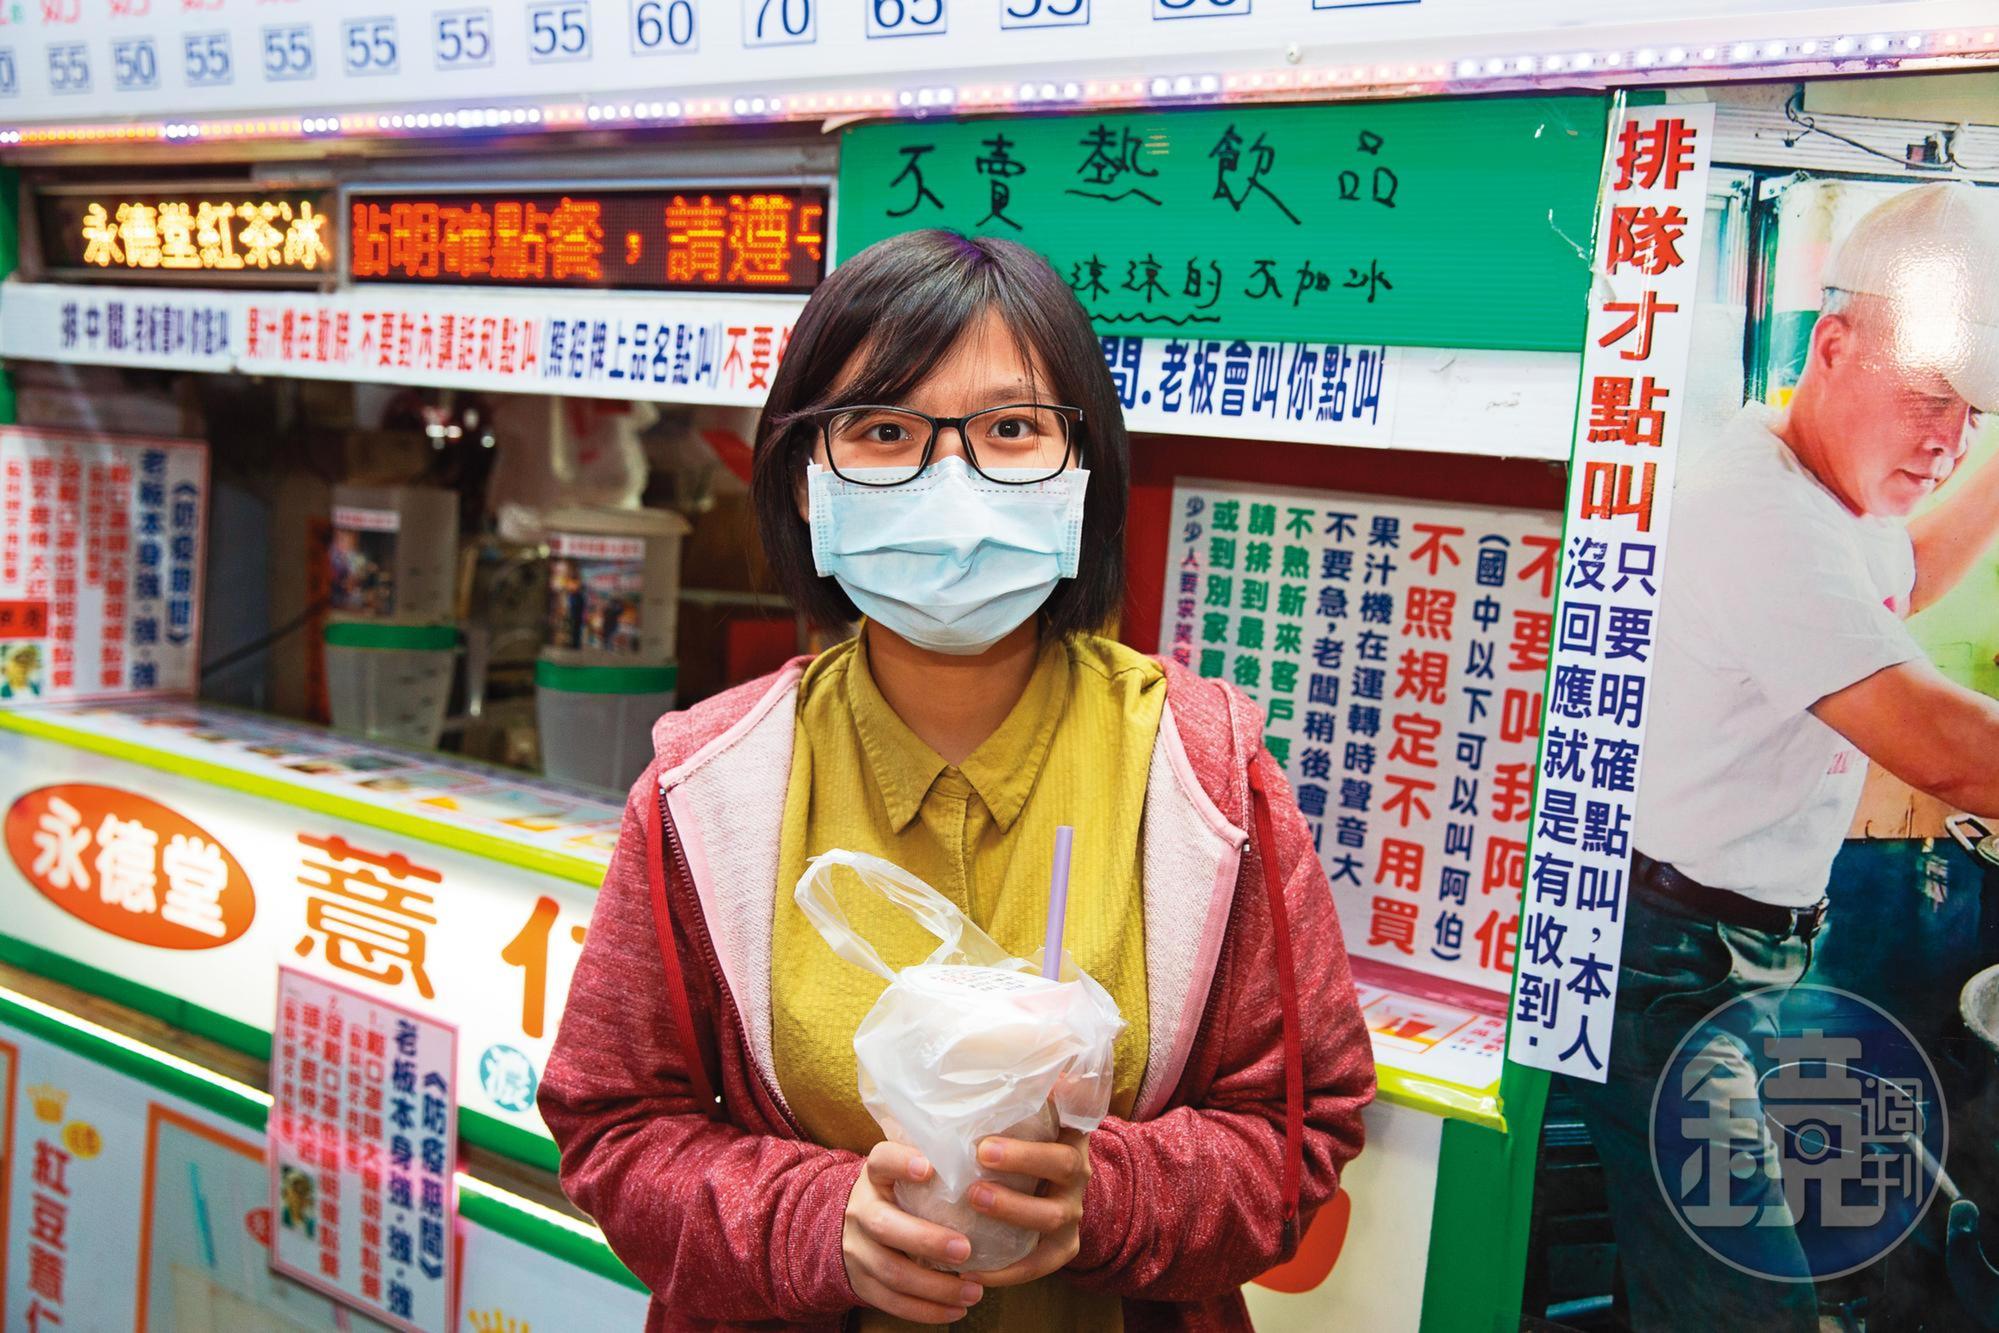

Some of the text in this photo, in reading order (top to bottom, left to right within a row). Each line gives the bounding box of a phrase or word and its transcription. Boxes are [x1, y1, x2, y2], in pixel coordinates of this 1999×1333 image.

[439, 19, 490, 61] 55
[532, 10, 588, 55] 55
[635, 0, 695, 48] 60
[752, 0, 810, 39] 70
[49, 48, 90, 89] 55
[114, 44, 156, 84] 50
[185, 38, 230, 79] 55
[265, 31, 312, 73] 55
[347, 26, 397, 68] 55
[82, 200, 333, 270] 永德堂紅茶冰
[1580, 117, 1698, 533] 排隊才點叫
[1232, 502, 1277, 700] 請排到最後
[1331, 515, 1401, 888] 果汁機在運轉時聲音大
[1368, 523, 1466, 956] 不照規定不用買
[31, 796, 229, 939] 永德堂
